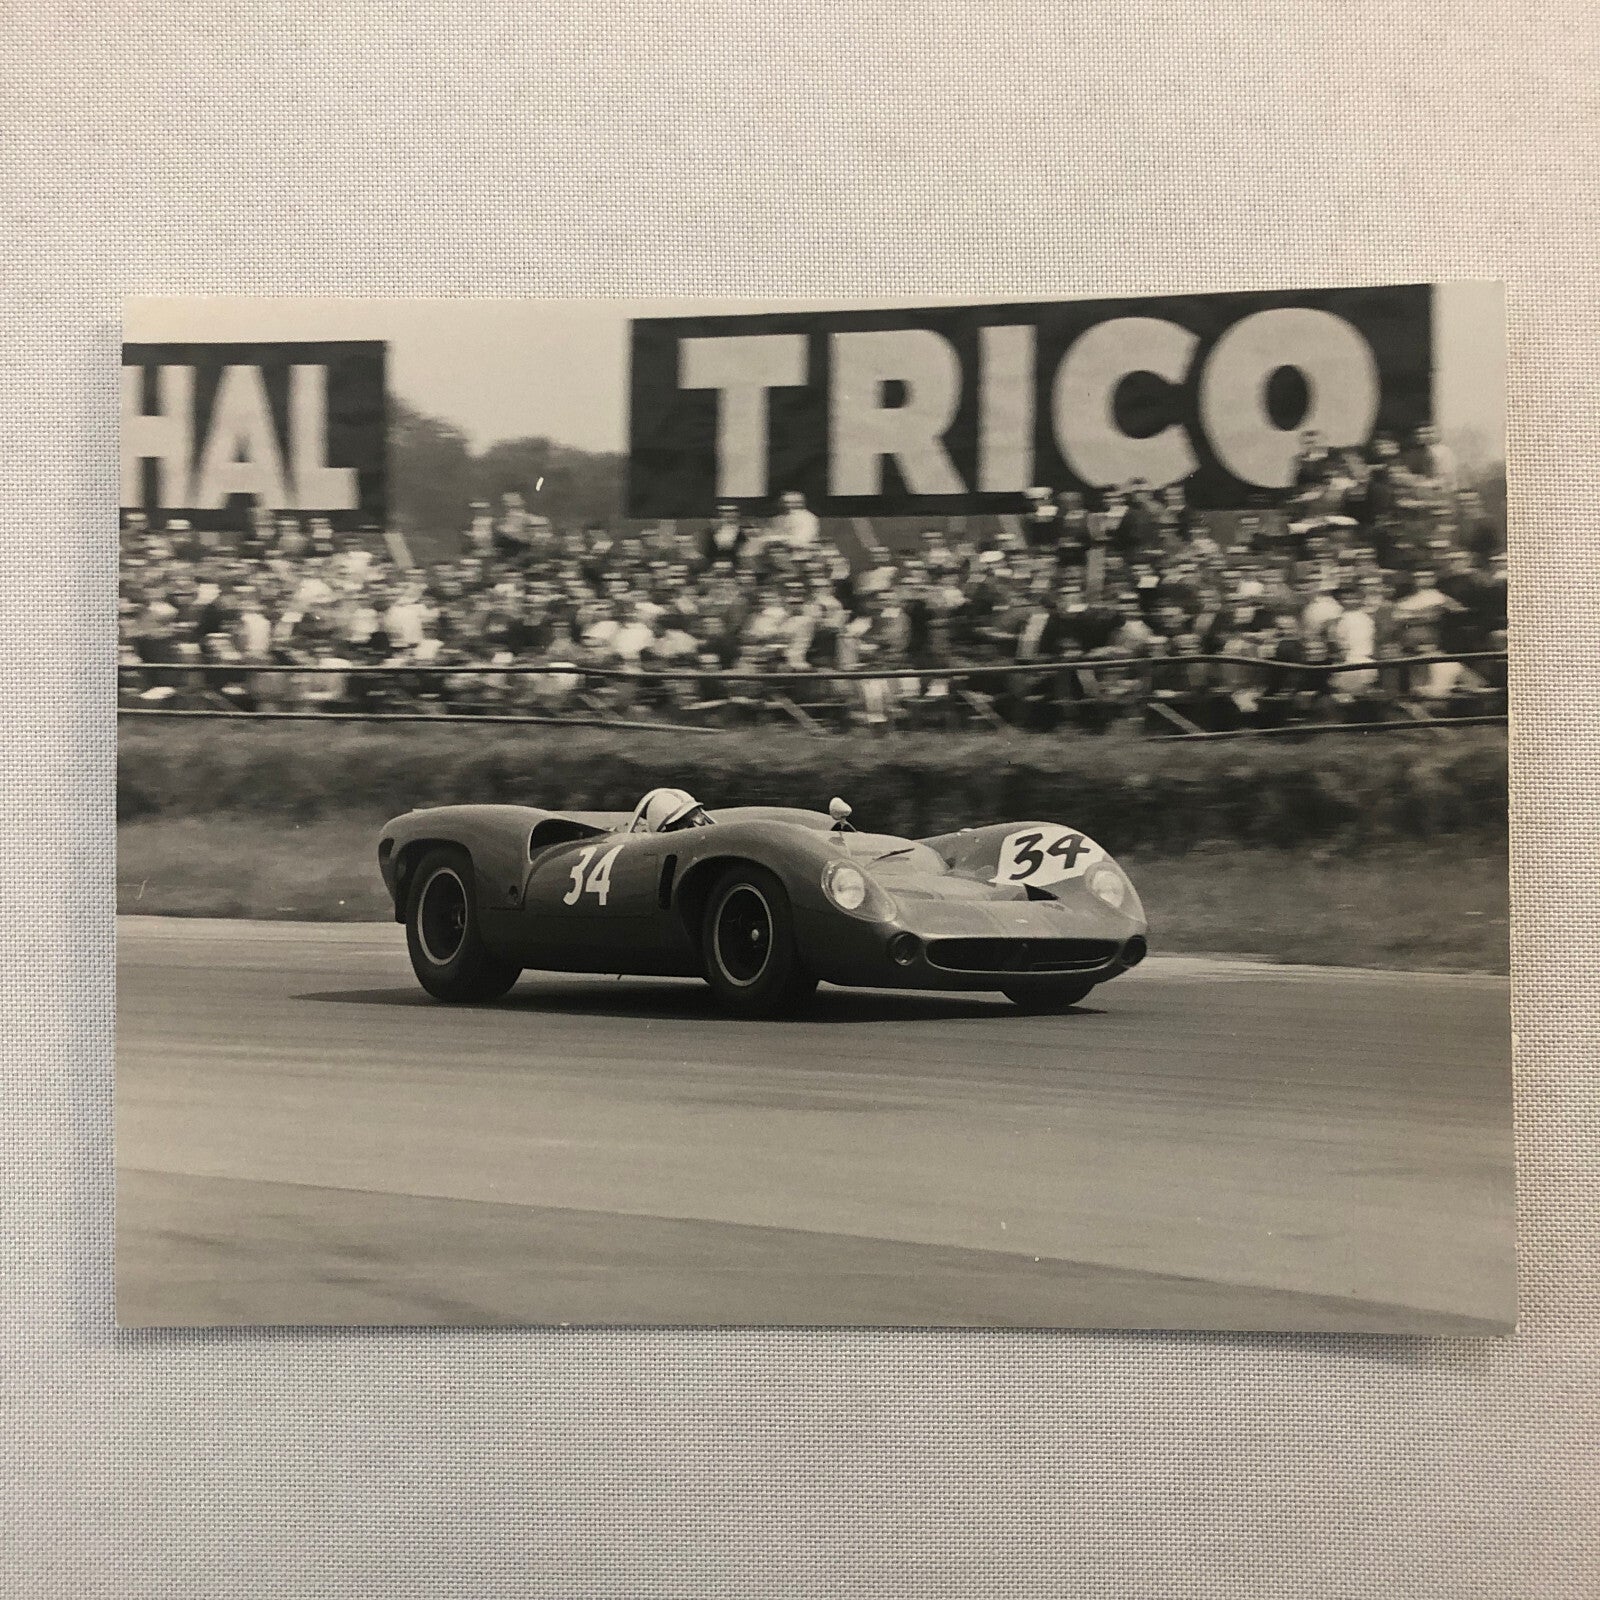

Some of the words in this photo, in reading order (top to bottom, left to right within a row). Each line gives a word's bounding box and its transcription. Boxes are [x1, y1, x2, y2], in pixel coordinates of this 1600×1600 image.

[120, 364, 359, 511] HAL
[678, 307, 1382, 498] TRICO
[563, 845, 624, 906] 34
[1009, 832, 1091, 880] 34
